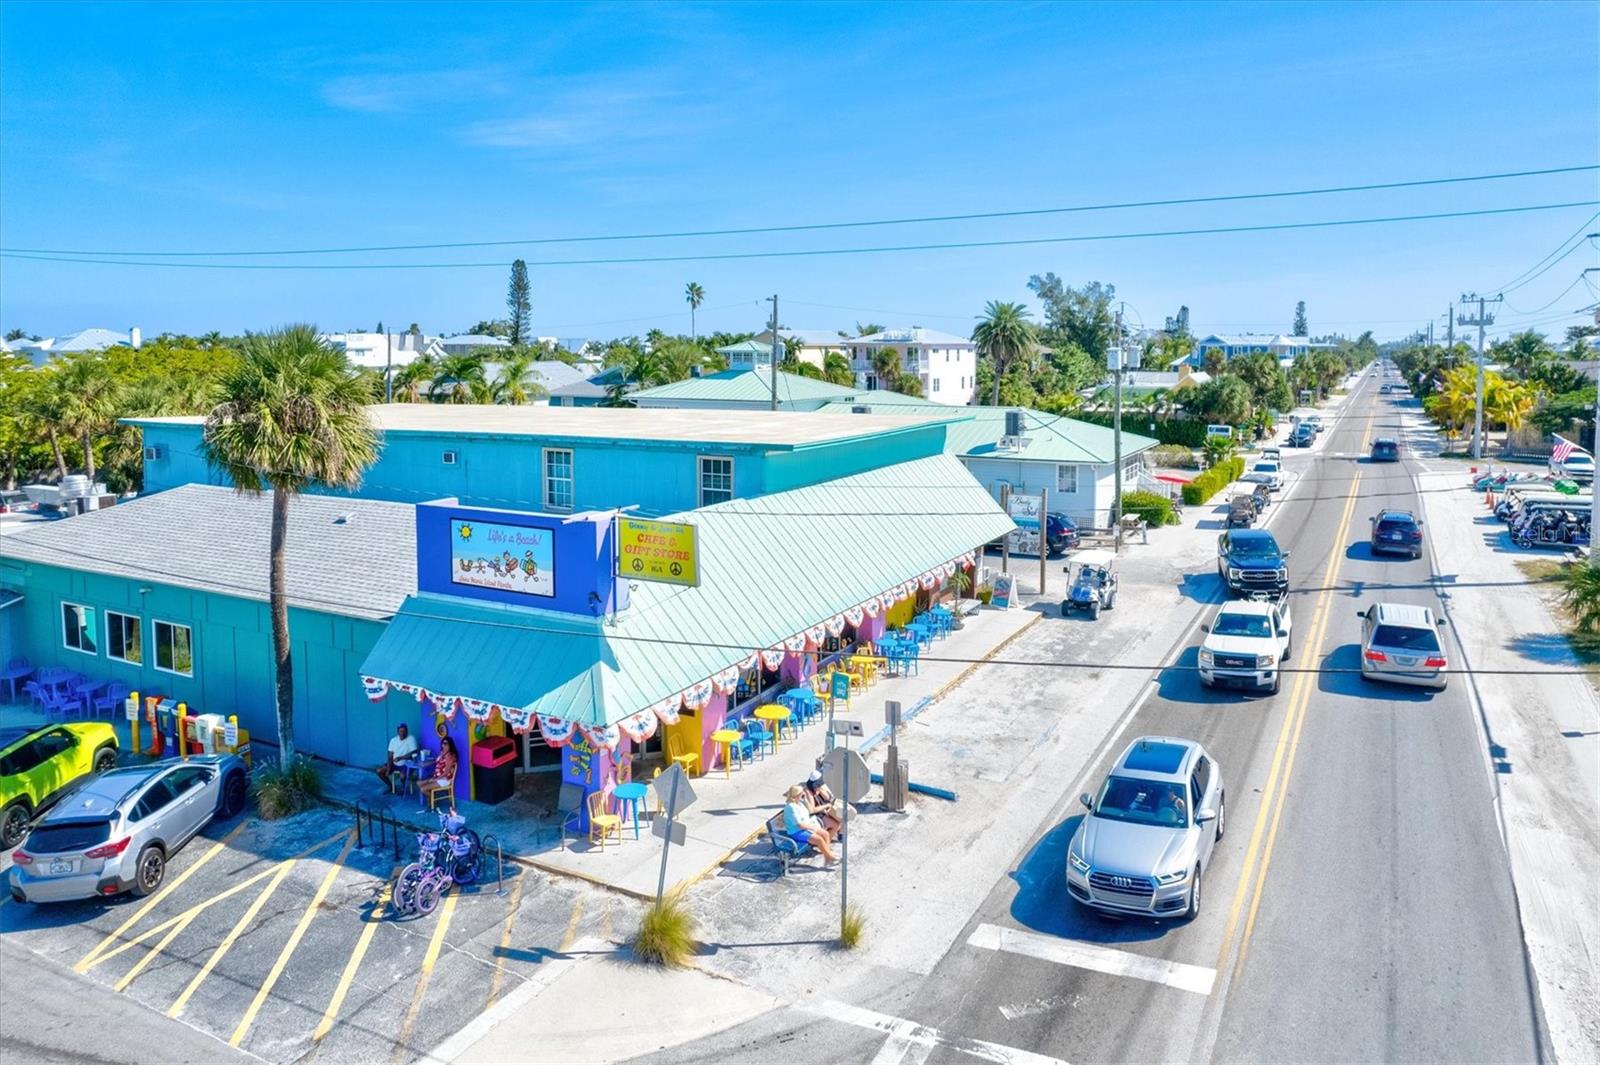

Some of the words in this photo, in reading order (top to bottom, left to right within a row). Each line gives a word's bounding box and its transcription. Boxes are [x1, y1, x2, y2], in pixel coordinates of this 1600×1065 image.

[487, 528, 507, 544] Life's
[509, 535, 514, 543] a
[515, 531, 542, 546] Beach!
[637, 533, 666, 545] CAFE
[669, 537, 678, 547] &
[624, 543, 652, 556] GIFT
[653, 547, 690, 561] STORE
